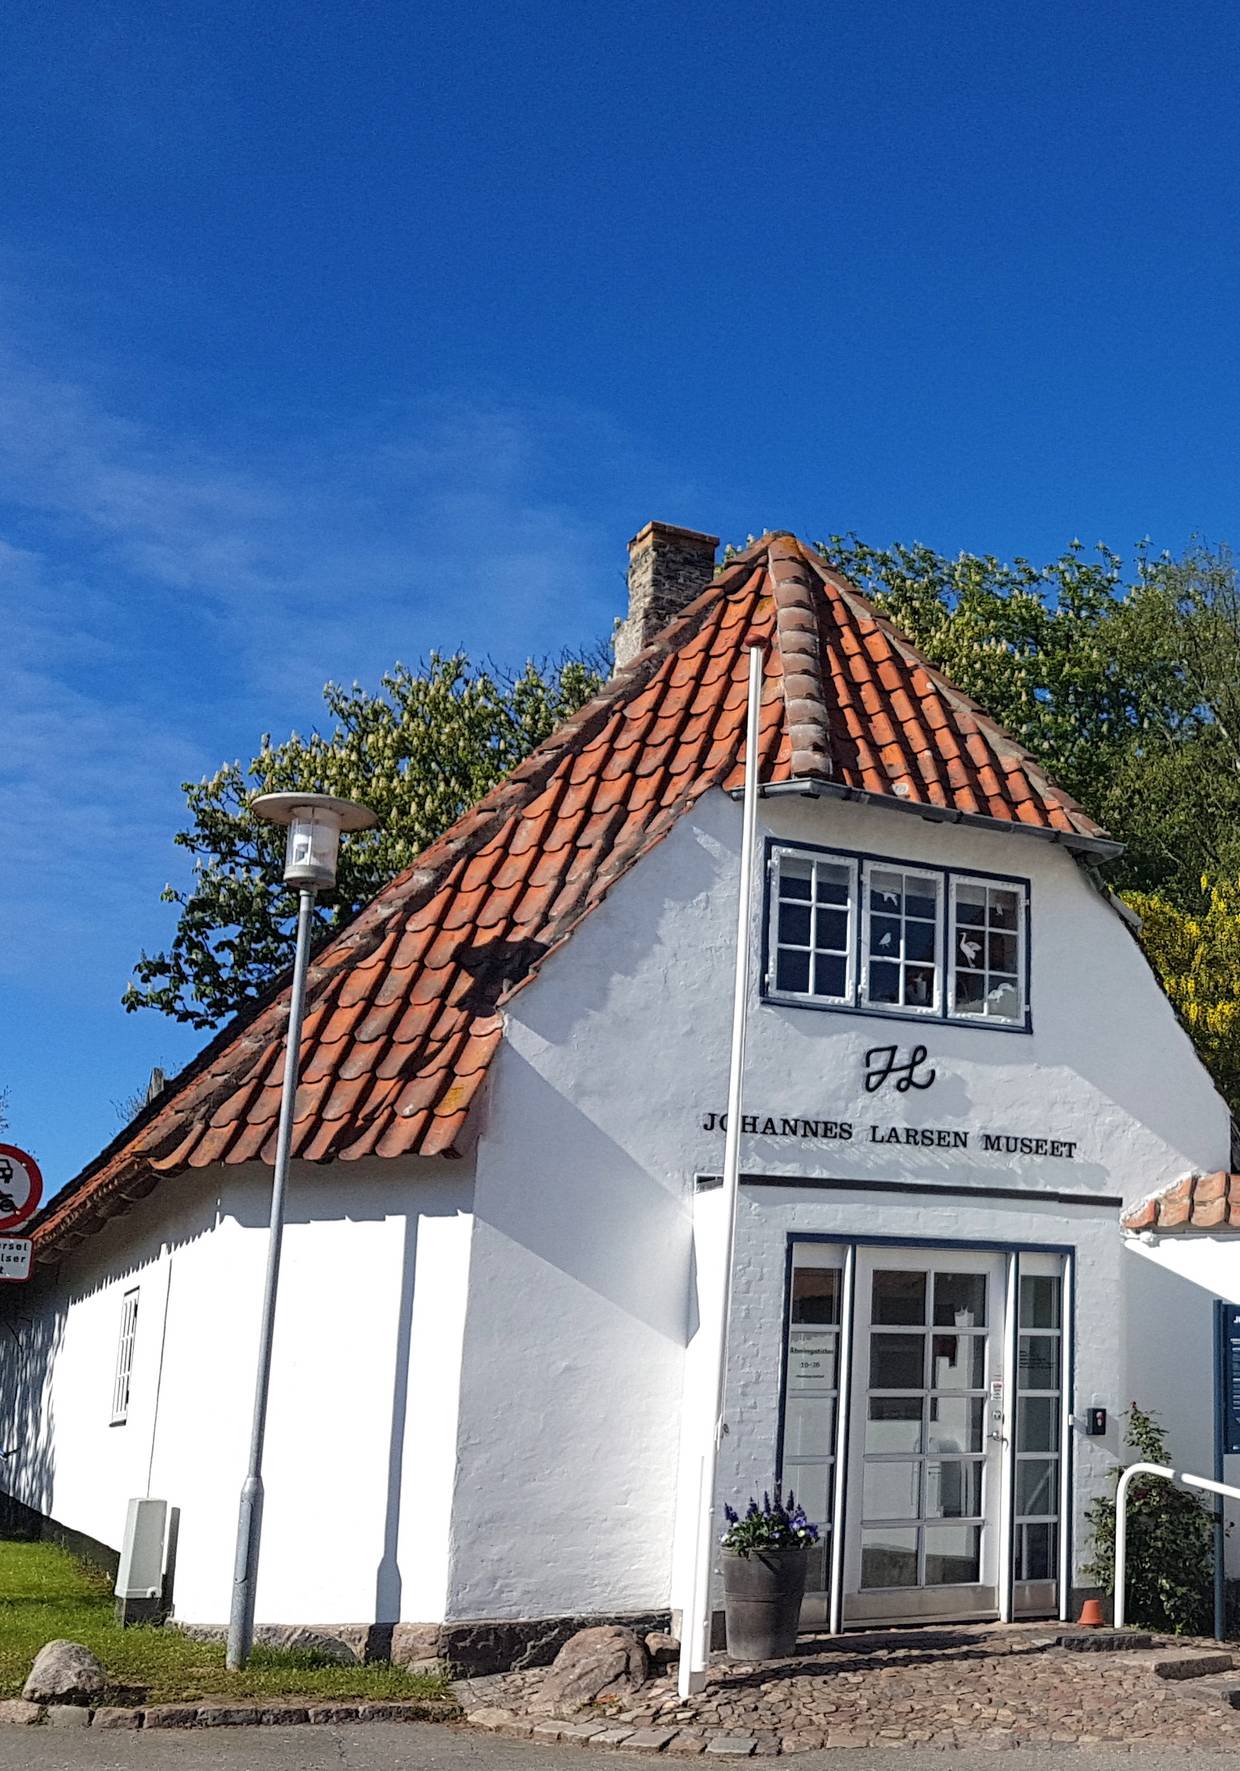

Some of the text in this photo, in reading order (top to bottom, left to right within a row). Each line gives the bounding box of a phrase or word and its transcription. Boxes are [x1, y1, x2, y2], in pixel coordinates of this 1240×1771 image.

[869, 1124, 970, 1148] LARSEN
[983, 1133, 1077, 1158] MUSEET
[0, 1242, 27, 1251] rsel
